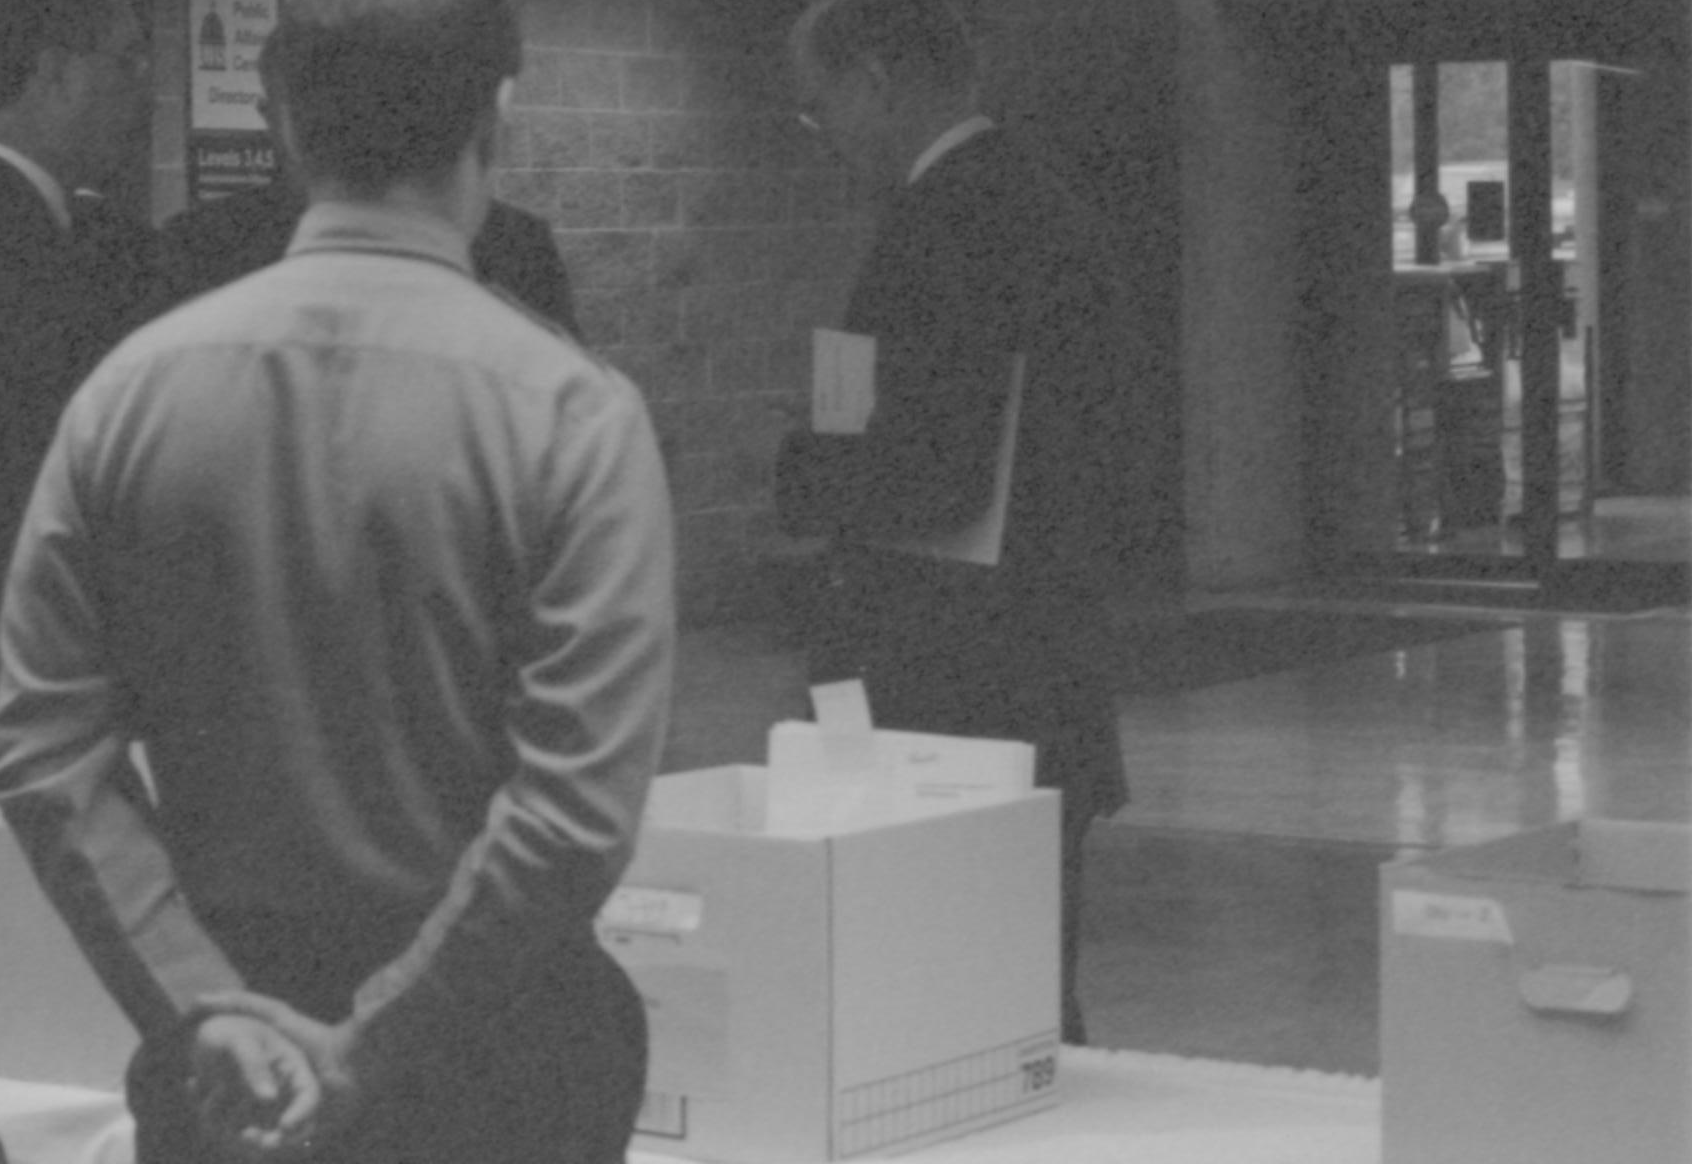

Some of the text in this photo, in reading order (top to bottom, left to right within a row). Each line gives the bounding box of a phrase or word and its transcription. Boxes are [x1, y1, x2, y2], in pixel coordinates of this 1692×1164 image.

[233, 0, 270, 19] Public
[198, 148, 240, 167] Levels
[1021, 1054, 1055, 1094] 789
